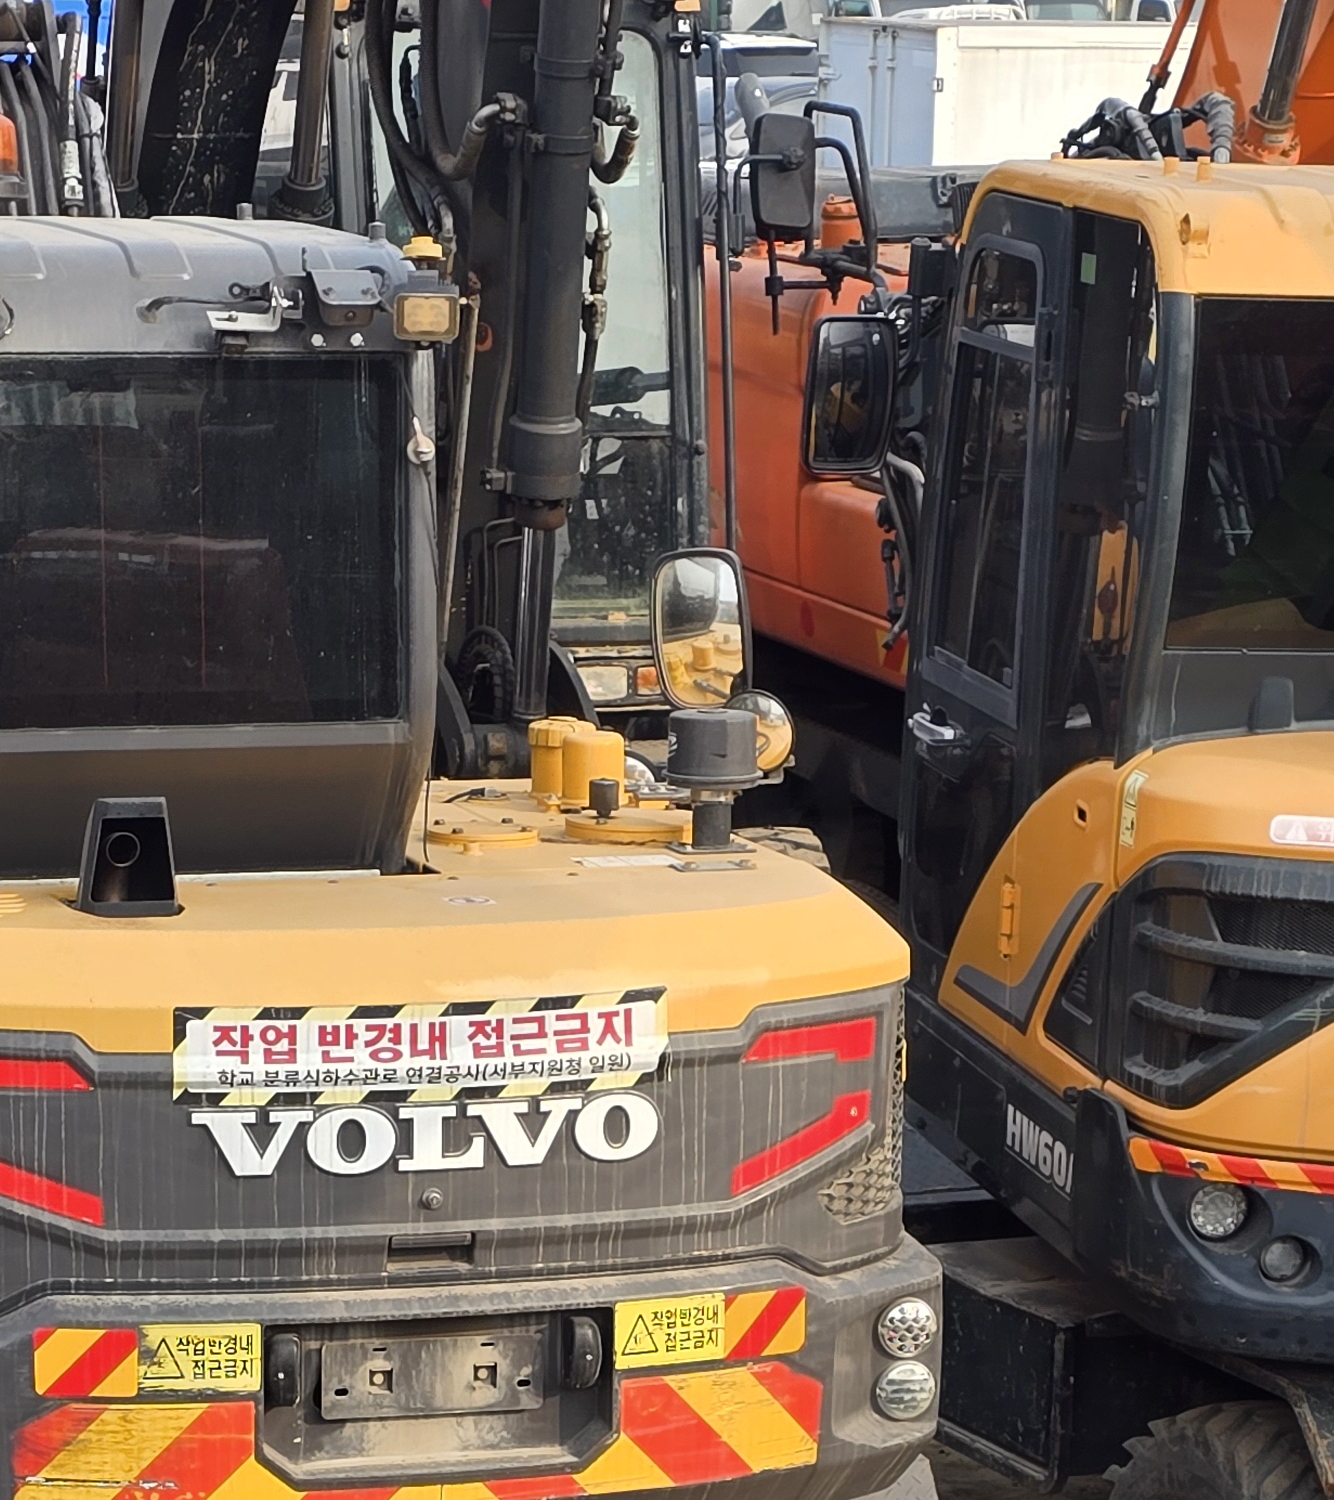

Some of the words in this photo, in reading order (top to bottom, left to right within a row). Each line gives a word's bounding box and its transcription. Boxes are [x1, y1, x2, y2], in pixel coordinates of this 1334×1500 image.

[211, 1024, 298, 1065] 작업
[317, 1020, 448, 1063] 반경내
[467, 1007, 635, 1060] 접근금지
[217, 1069, 256, 1088] 학교
[262, 1067, 400, 1088] 분류식하수관로
[588, 1052, 632, 1072] 일원)
[191, 1093, 660, 1177] VOLVO
[665, 1329, 719, 1353] 접근금지
[192, 1359, 254, 1379] 접근금지
